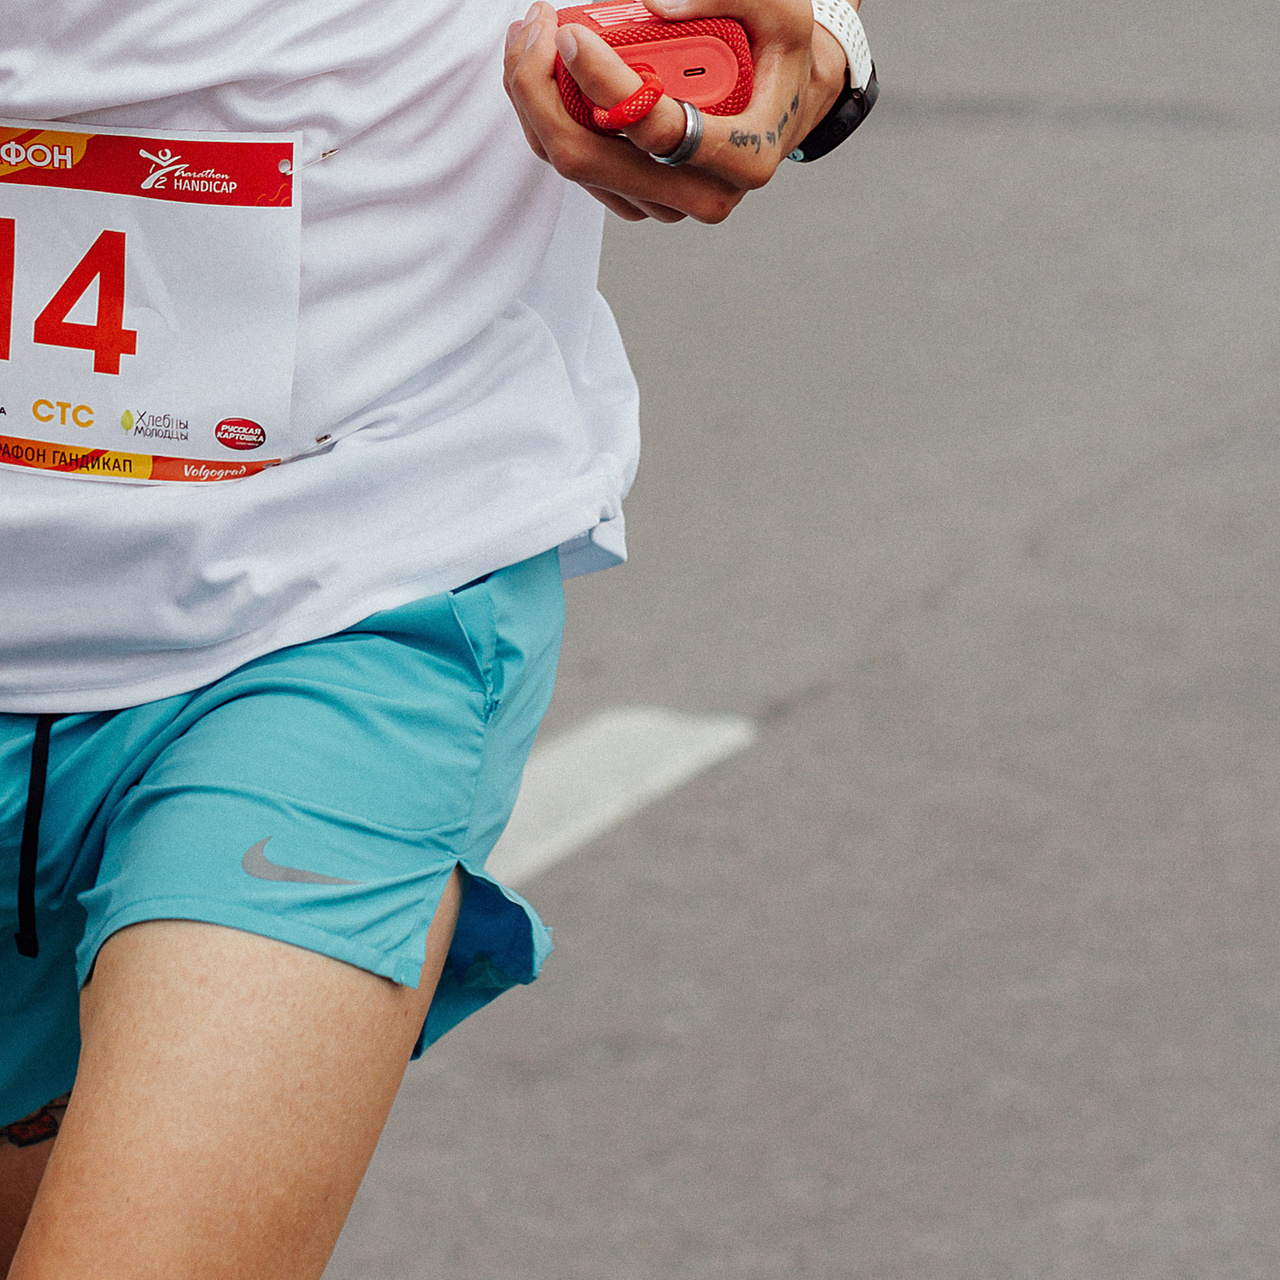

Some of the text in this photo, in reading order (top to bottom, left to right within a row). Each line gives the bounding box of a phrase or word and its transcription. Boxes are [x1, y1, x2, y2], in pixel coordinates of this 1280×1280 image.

[174, 178, 238, 194] HANDICAP
[32, 399, 95, 428] СТС
[136, 409, 189, 430] Хлебцы
[220, 424, 262, 436] РУССКАЯ
[52, 450, 133, 473] ГАНДИКАП
[183, 464, 247, 481] Volgograd
